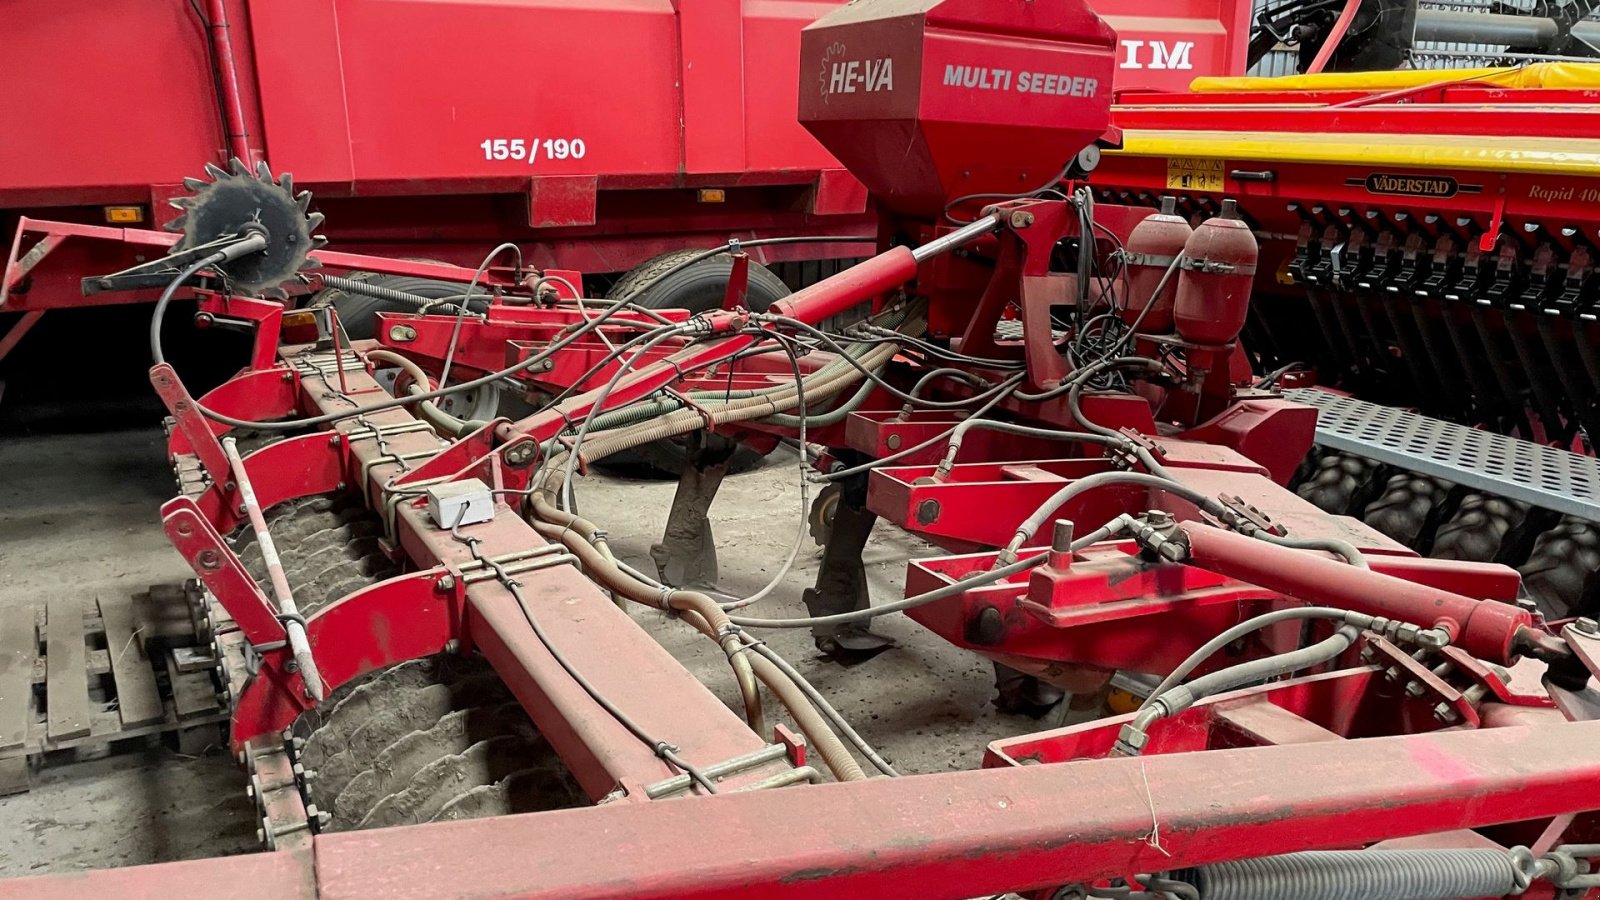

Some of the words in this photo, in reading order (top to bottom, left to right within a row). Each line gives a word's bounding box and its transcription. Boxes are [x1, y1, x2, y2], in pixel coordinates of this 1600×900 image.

[829, 58, 893, 94] HE-VA
[943, 64, 1012, 91] MULTI
[1016, 71, 1098, 98] SEEDER
[480, 138, 586, 165] 155/190
[1372, 175, 1450, 195] VÄDERSTAD
[1528, 184, 1575, 203] Rapid
[1578, 188, 1600, 203] 40
